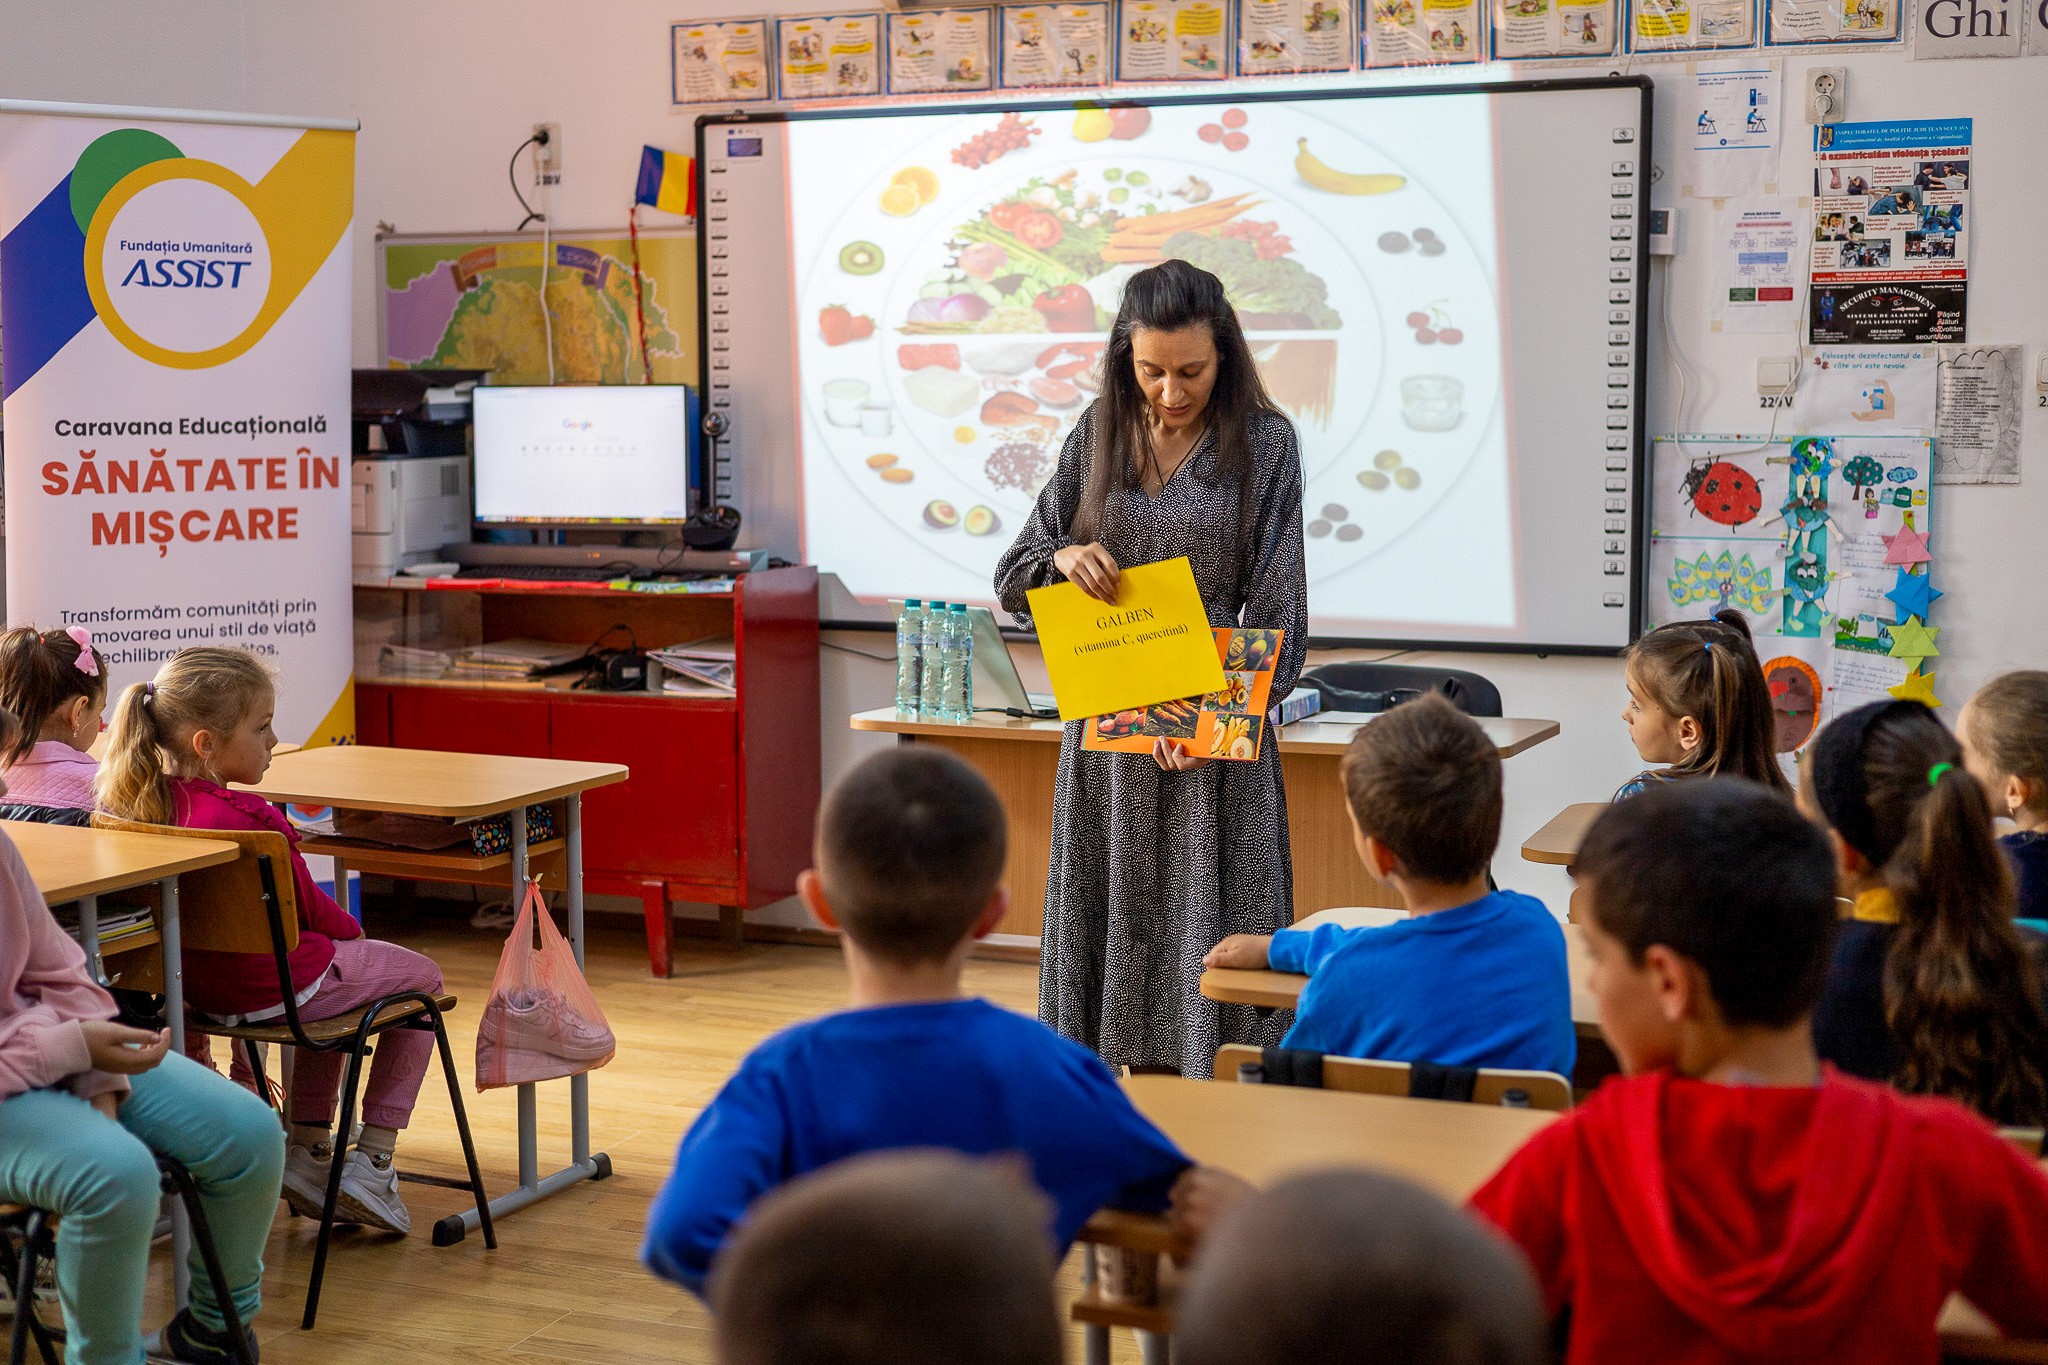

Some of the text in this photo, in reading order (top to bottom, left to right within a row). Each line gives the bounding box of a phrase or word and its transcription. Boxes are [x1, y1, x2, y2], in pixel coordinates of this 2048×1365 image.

[1925, 0, 2011, 38] Ghi
[120, 240, 253, 255] Fundația Umanitară
[121, 258, 252, 288] ASSIST
[1839, 286, 1937, 312] SECURITY MANAGEMENT
[1858, 352, 1910, 360] dezinfectantul
[1785, 396, 1793, 407] V
[55, 415, 327, 441] Caravana Educațională
[562, 418, 593, 430] Google
[42, 446, 339, 496] SĂNĂTATE ÎN
[92, 507, 299, 559] MIȘCARE
[61, 599, 317, 625] Transformăm comunități prin
[1096, 607, 1155, 630] GALBEN
[91, 620, 316, 644] movarea unui stil de viață
[101, 647, 184, 665] echilibra
[1074, 639, 1121, 657] (vitamina
[1122, 633, 1134, 646] C,
